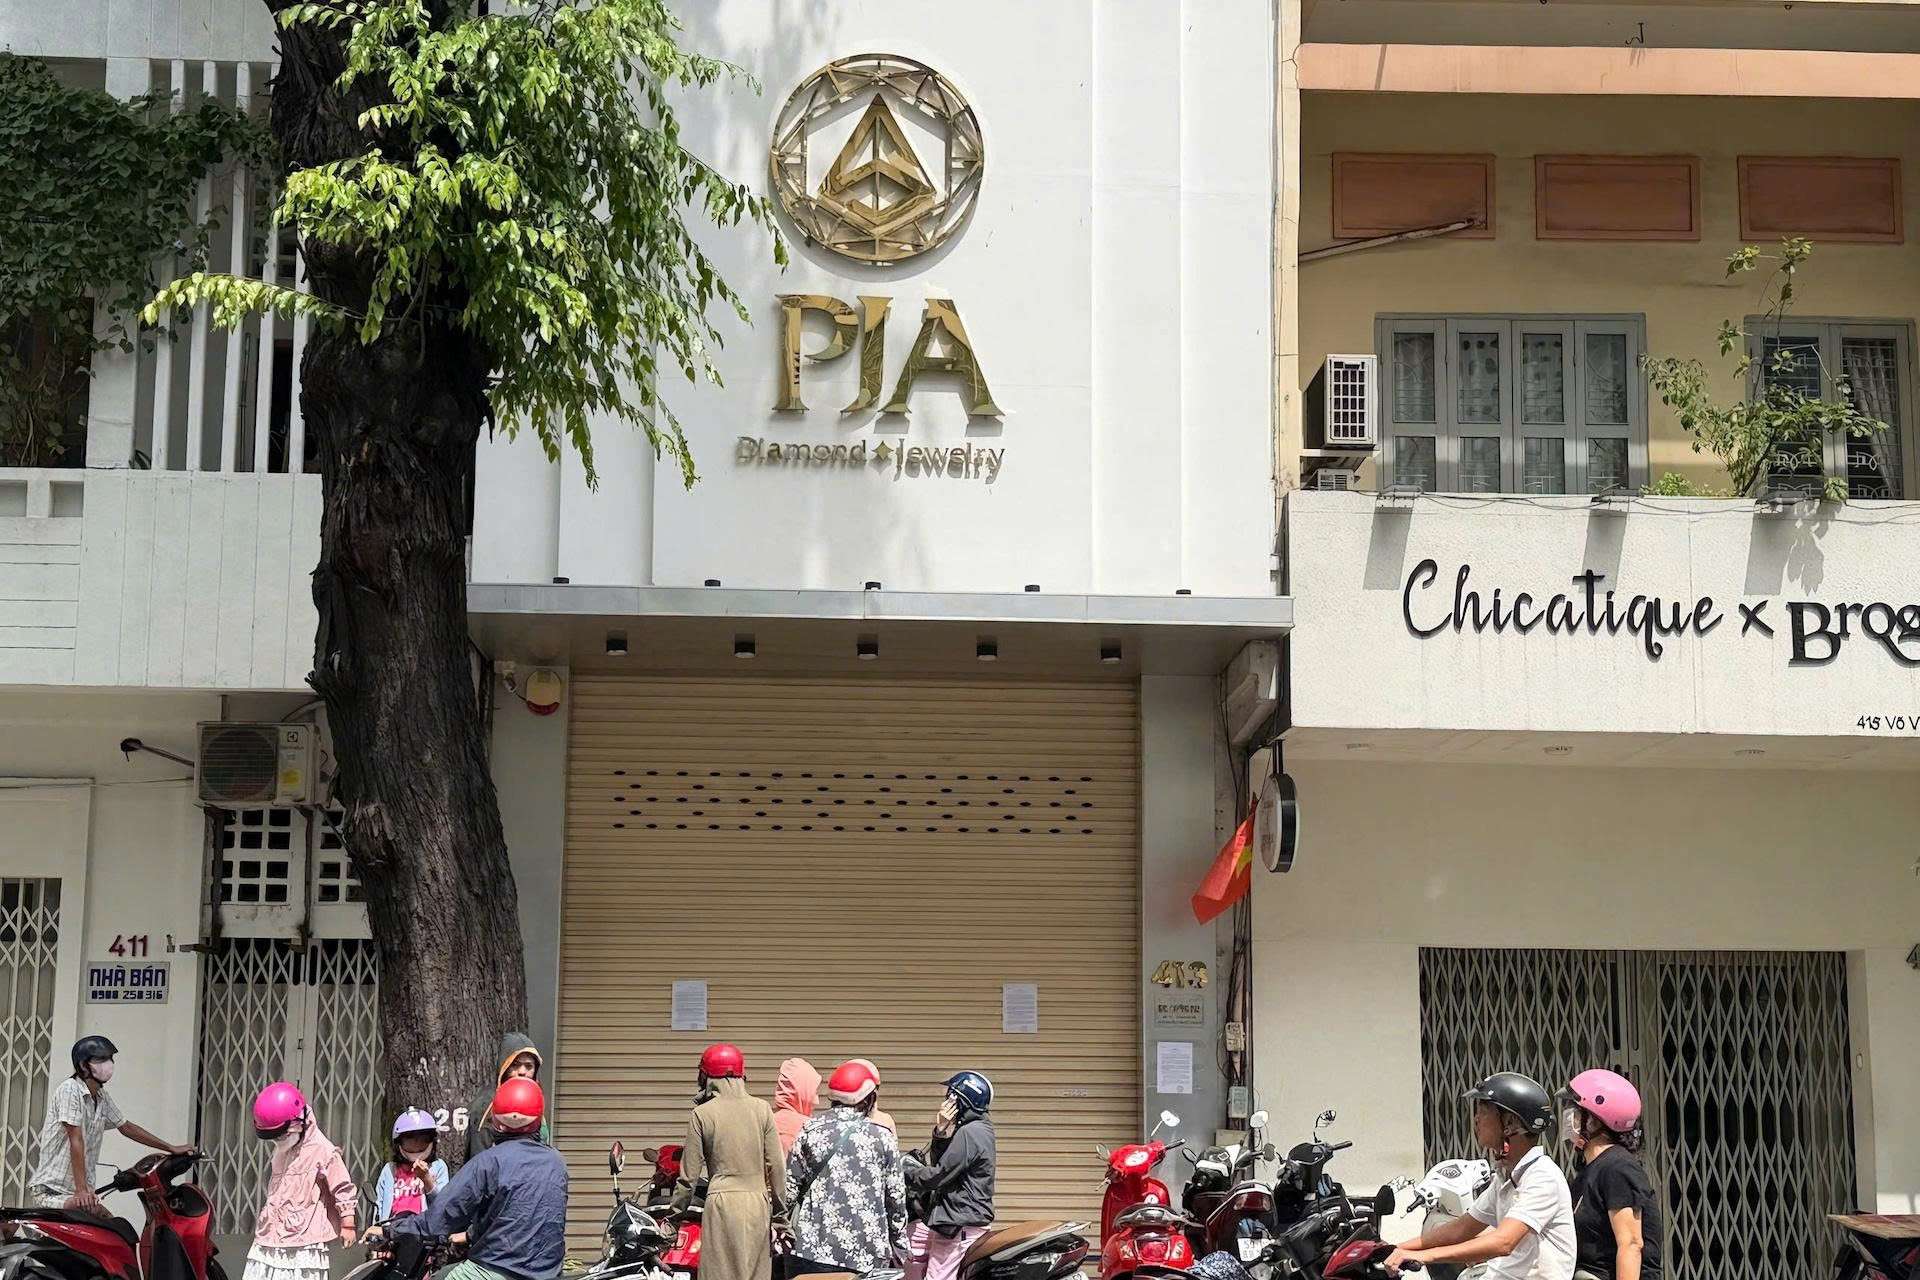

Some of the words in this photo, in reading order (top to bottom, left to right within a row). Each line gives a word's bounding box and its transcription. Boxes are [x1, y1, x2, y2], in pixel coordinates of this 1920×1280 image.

[772, 294, 1005, 416] PJA
[736, 436, 867, 463] Diamond
[895, 438, 1005, 478] Jewelry
[1402, 558, 1723, 661] Chicatique
[1857, 715, 1881, 731] 415
[1885, 716, 1905, 730] Võ
[108, 934, 149, 957] 411
[89, 965, 126, 987] NHÀ
[130, 965, 166, 987] BÁN
[1151, 960, 1208, 989] 413
[145, 990, 163, 1000] 316
[434, 1107, 470, 1134] 26
